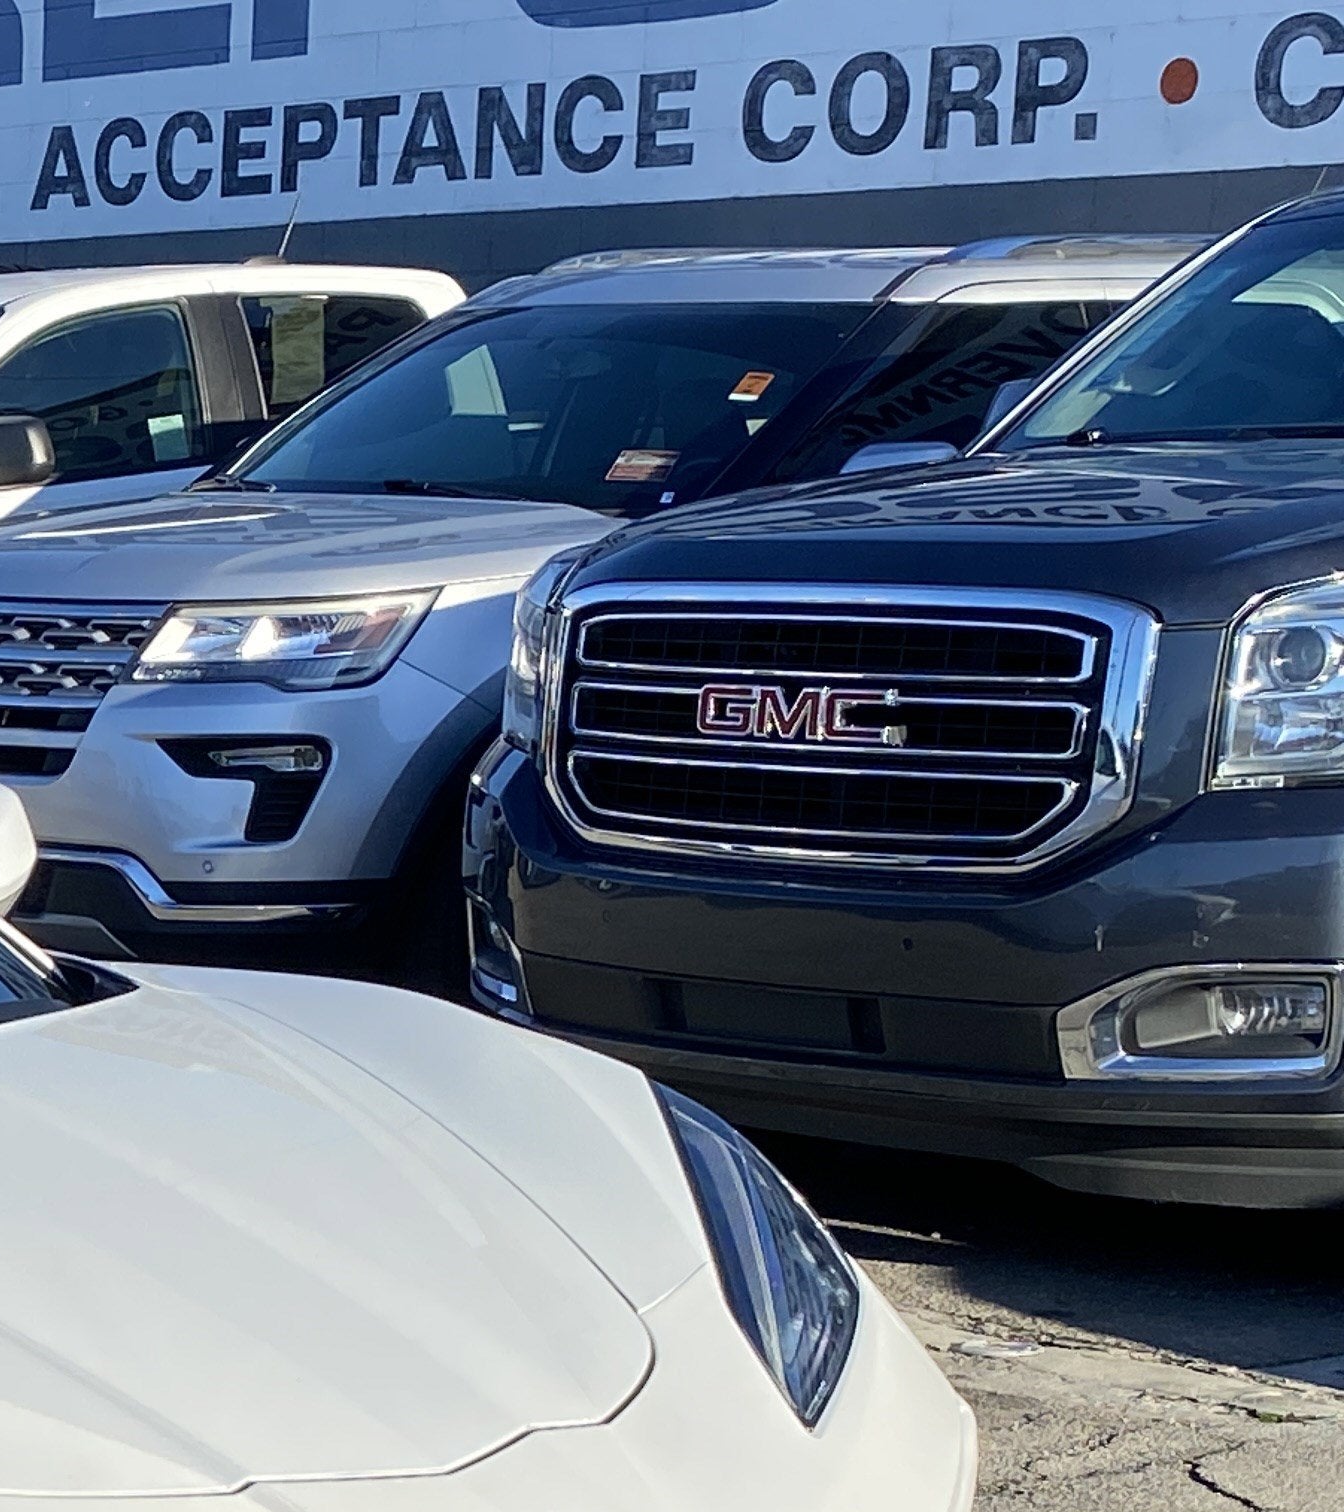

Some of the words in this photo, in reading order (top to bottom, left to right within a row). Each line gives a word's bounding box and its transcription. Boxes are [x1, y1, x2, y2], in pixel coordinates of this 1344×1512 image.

[29, 69, 698, 211] ACCEPTANCE
[741, 35, 1099, 164] CORP.
[696, 683, 902, 746] GMC
